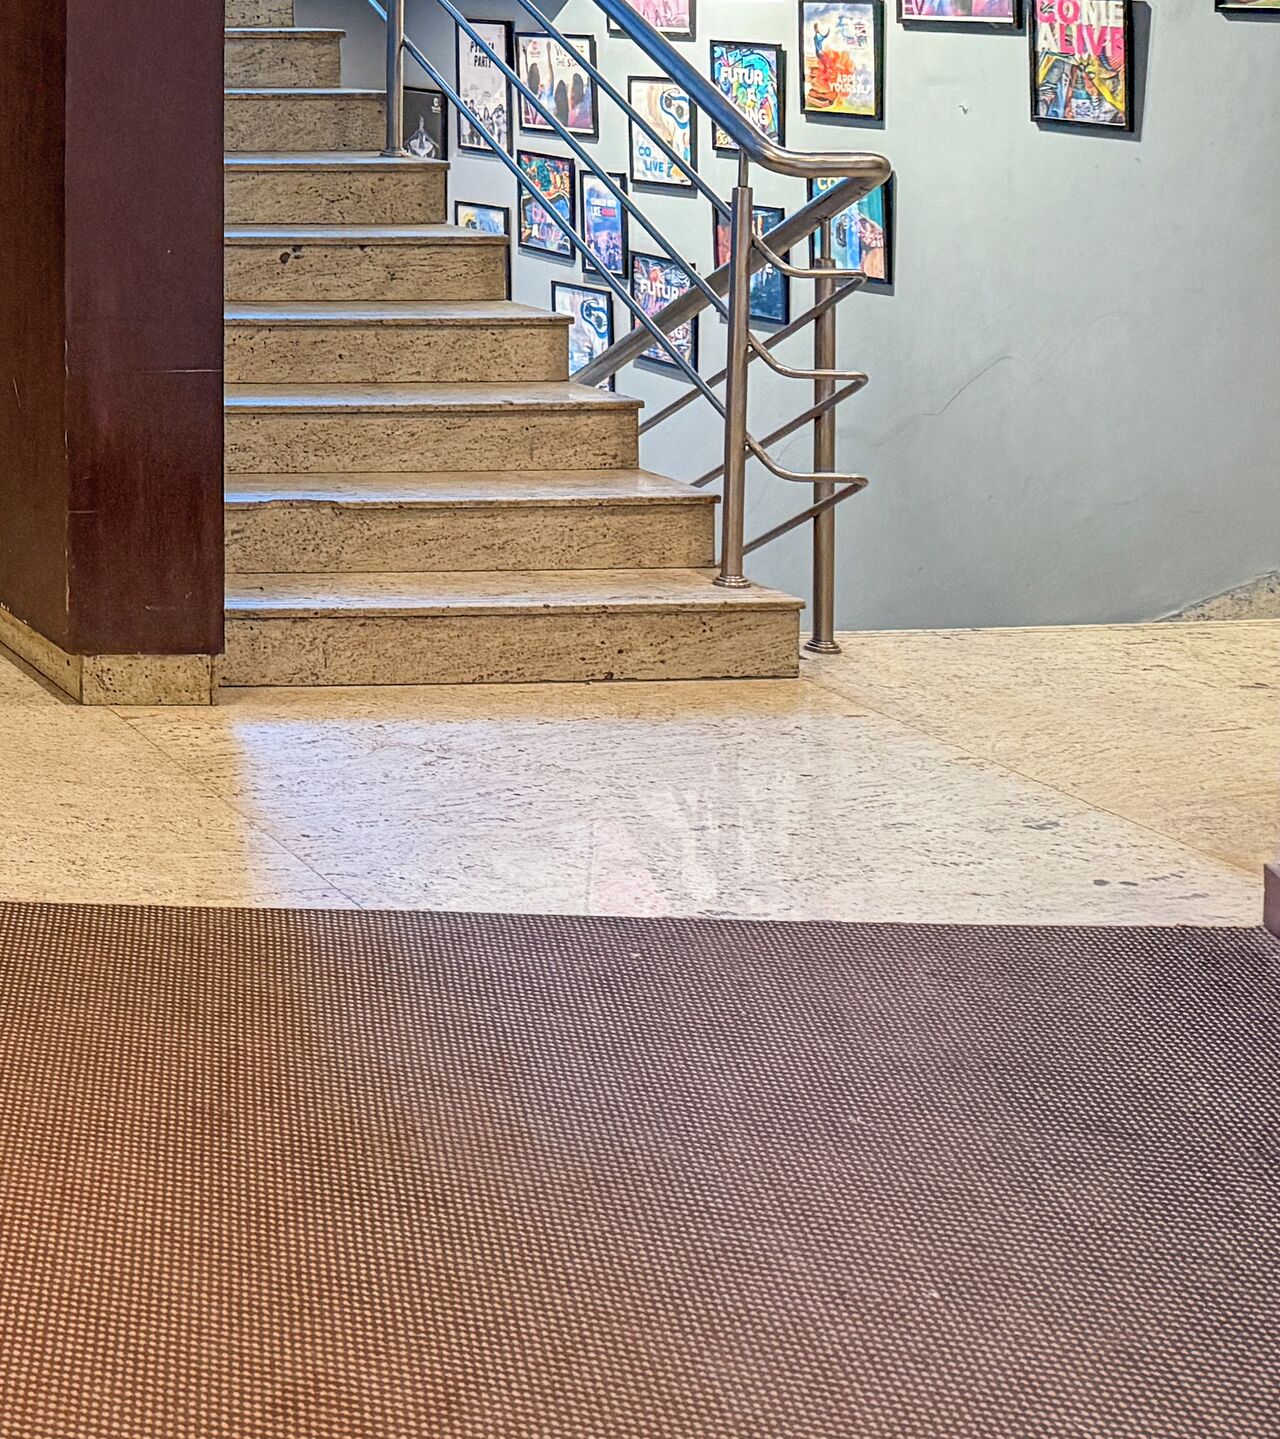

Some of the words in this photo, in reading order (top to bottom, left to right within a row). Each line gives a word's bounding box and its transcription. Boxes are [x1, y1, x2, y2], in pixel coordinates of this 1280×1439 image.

[829, 81, 872, 94] YOURSELF
[638, 146, 652, 157] CO
[644, 160, 665, 173] LIVE
